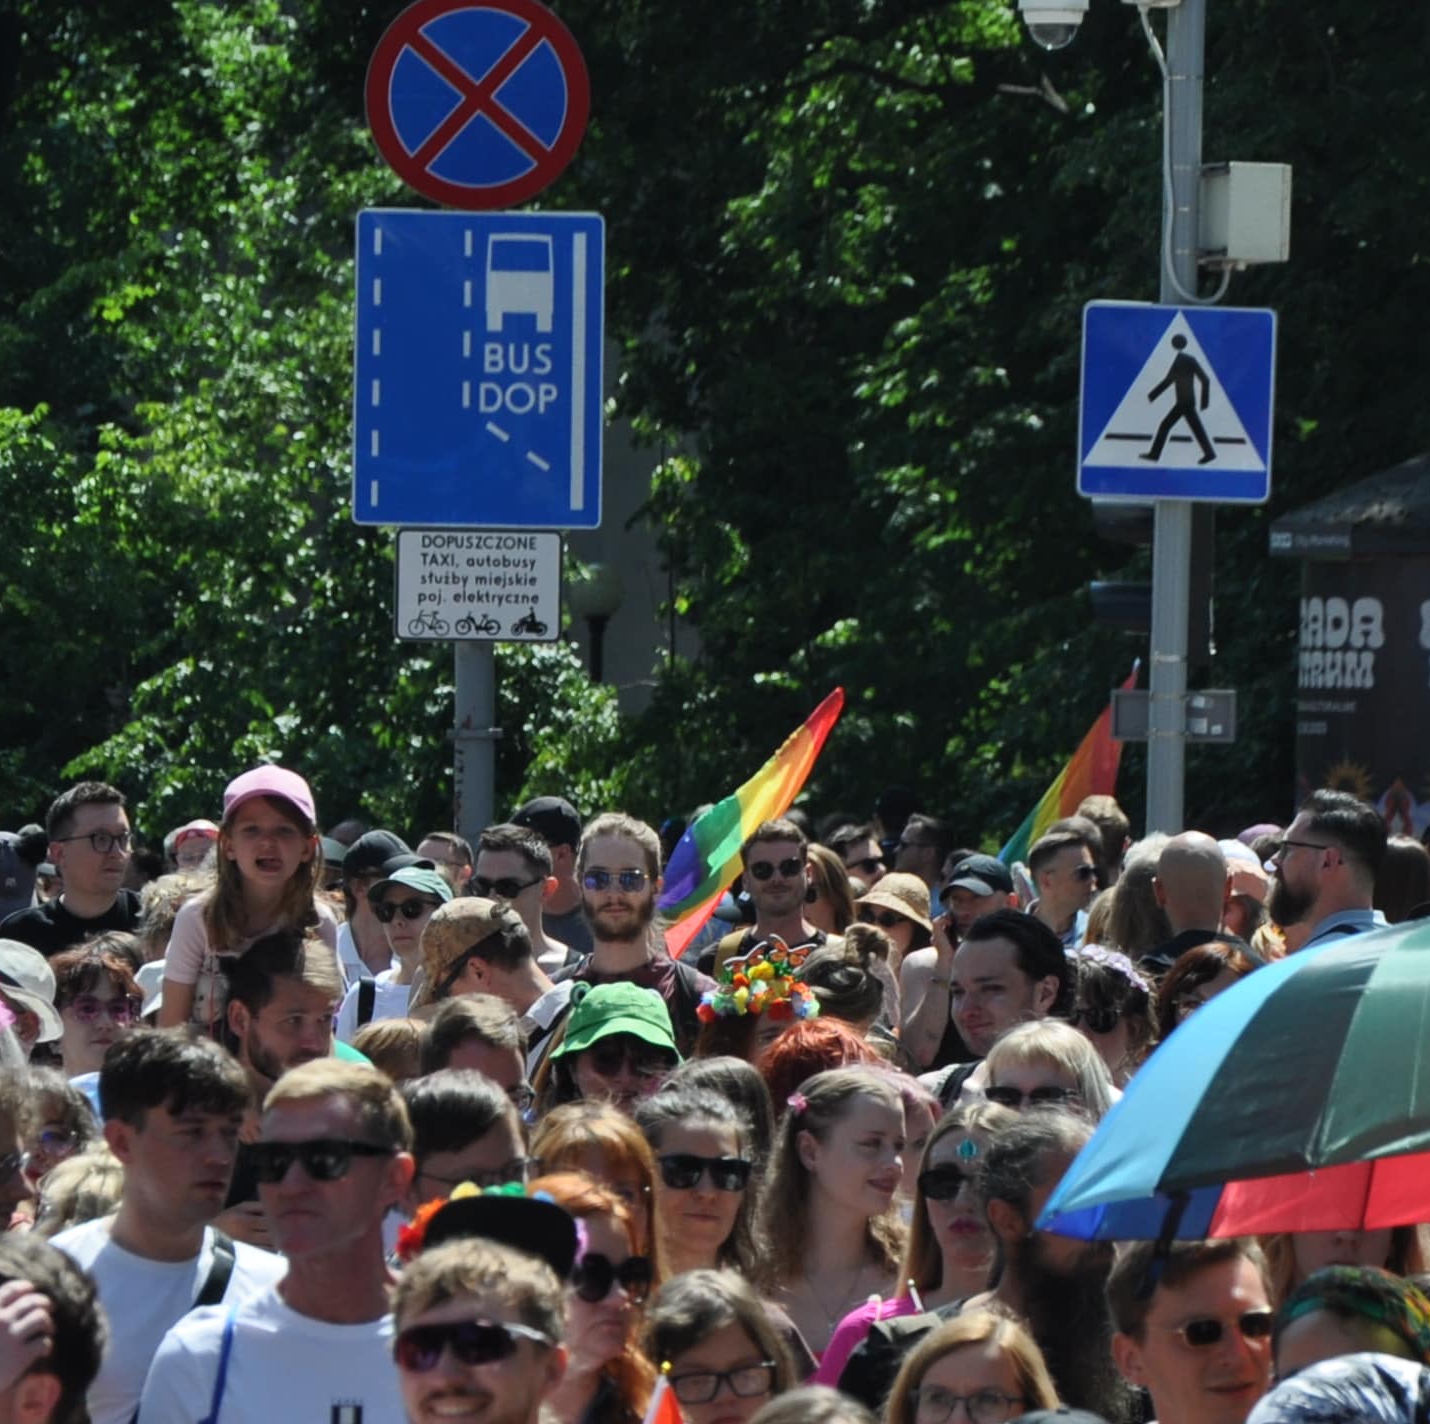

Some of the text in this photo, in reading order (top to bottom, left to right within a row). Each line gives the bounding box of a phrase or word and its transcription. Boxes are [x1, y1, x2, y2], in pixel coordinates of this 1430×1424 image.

[484, 343, 552, 374] BUS
[479, 383, 558, 414] DOP
[421, 535, 538, 550] DOPUSZCZONE
[421, 552, 536, 572] TAXI, autobusy
[420, 570, 538, 589] służby miejskie
[417, 589, 540, 608] poj. elektryczne
[1300, 597, 1385, 650] ADA
